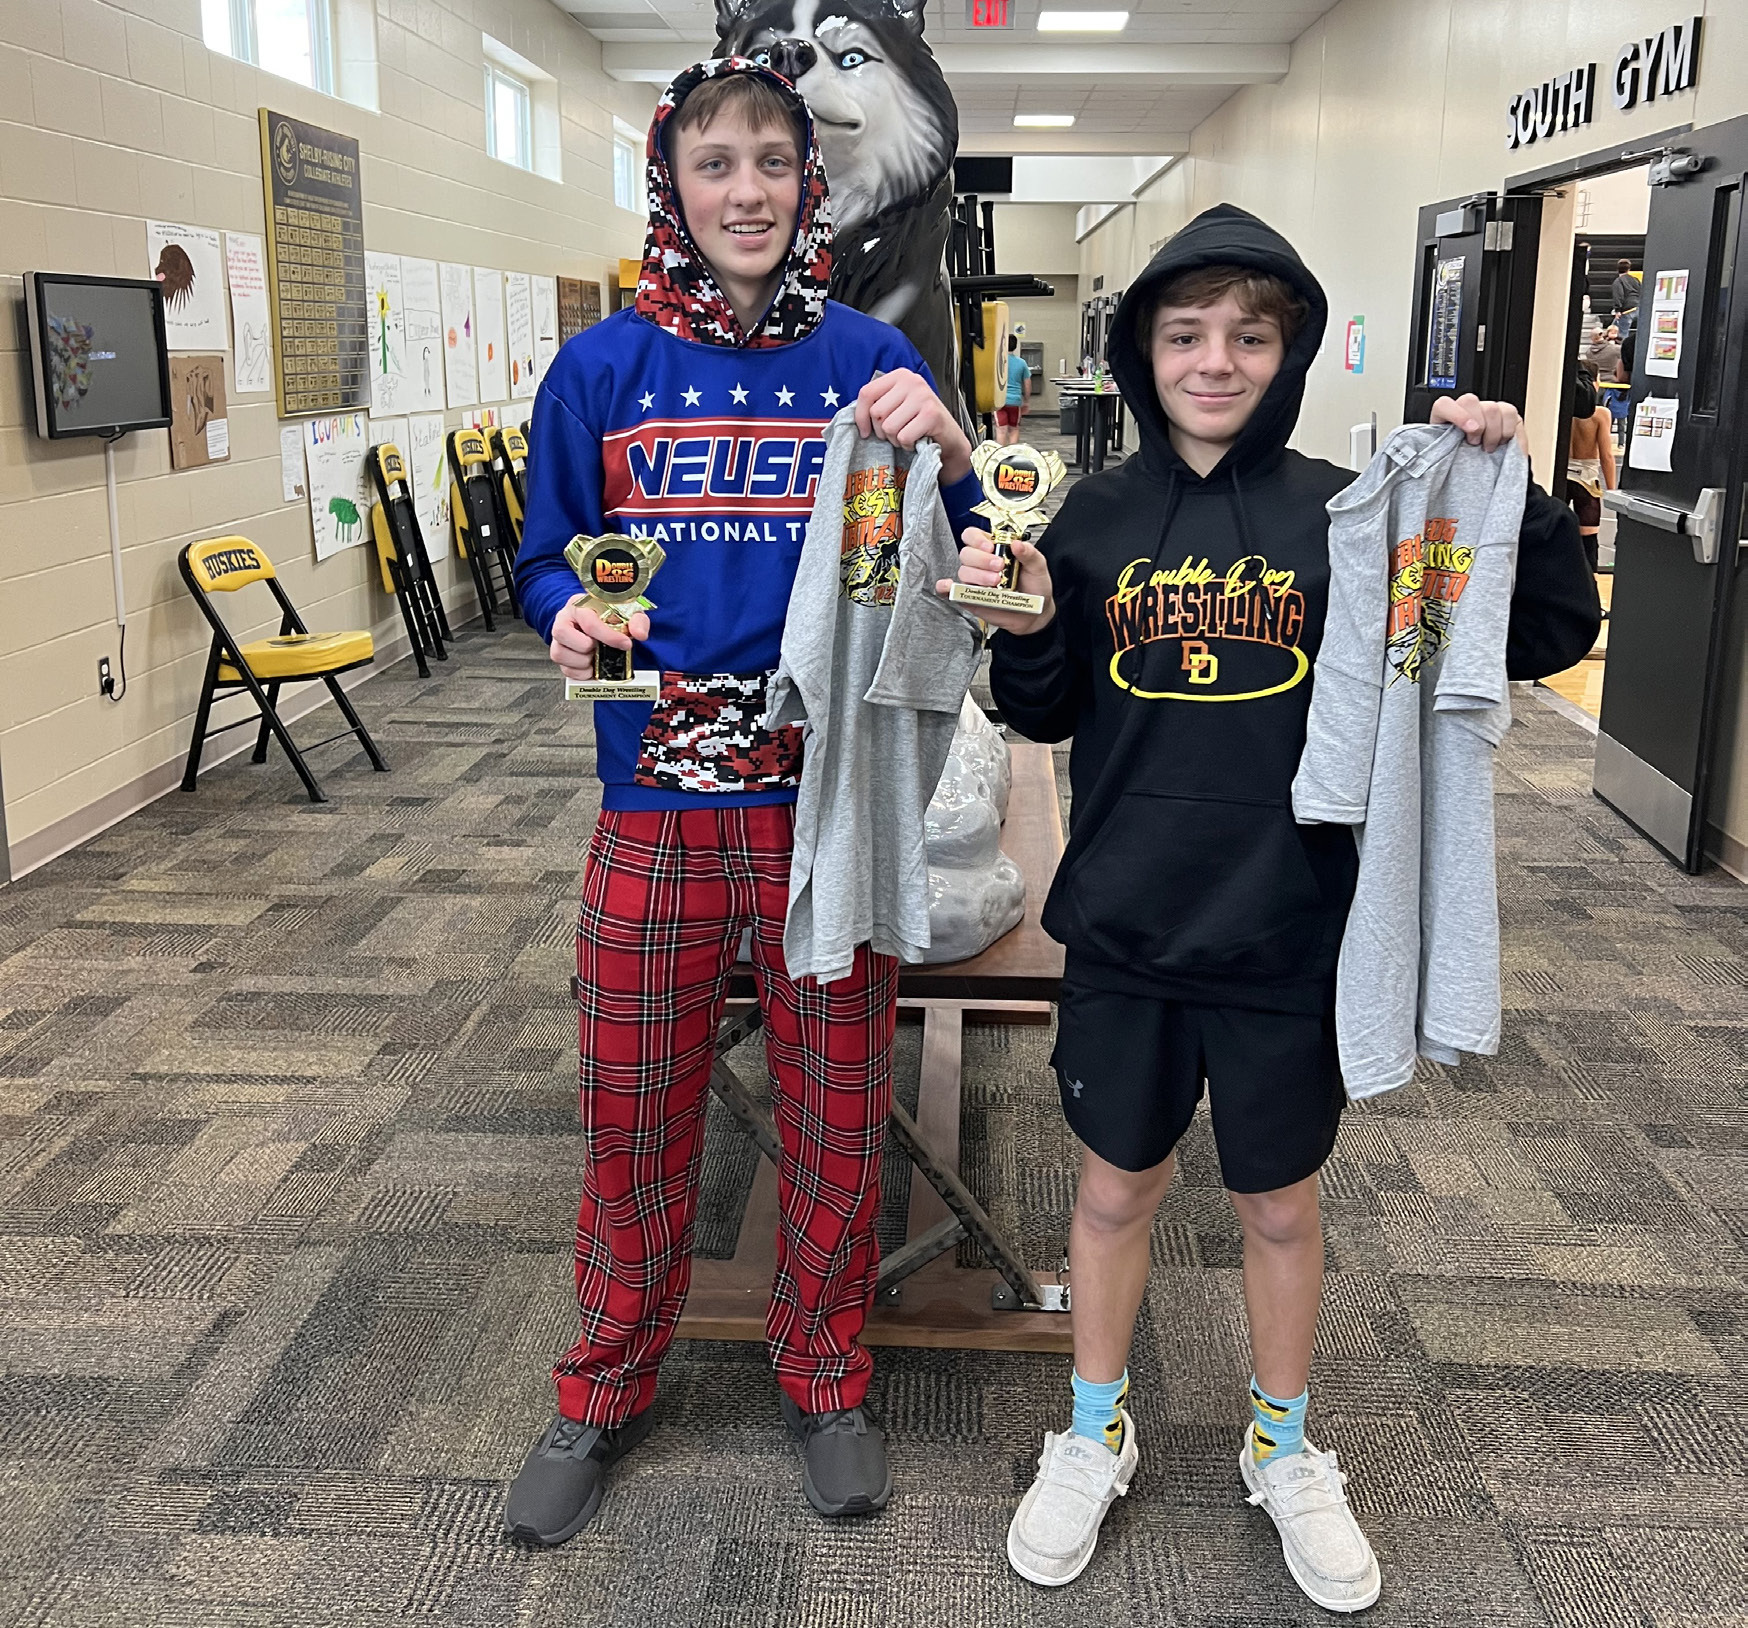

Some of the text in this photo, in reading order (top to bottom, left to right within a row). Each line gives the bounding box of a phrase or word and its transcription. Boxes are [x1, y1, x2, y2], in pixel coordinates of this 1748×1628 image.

[973, 0, 1009, 26] EXIT
[1505, 16, 1703, 149] SOUTH GYM
[998, 480, 1034, 493] WRESTLING
[630, 522, 777, 542] NATIONAL
[202, 548, 261, 580] HUSKIES
[597, 575, 634, 583] WRESTLING
[1117, 555, 1295, 604] Double Dog
[960, 593, 1034, 609] TOURNAMENT CHAMPION
[964, 588, 1030, 603] Double Dog Wrestling
[1105, 578, 1305, 652] WRESTLING
